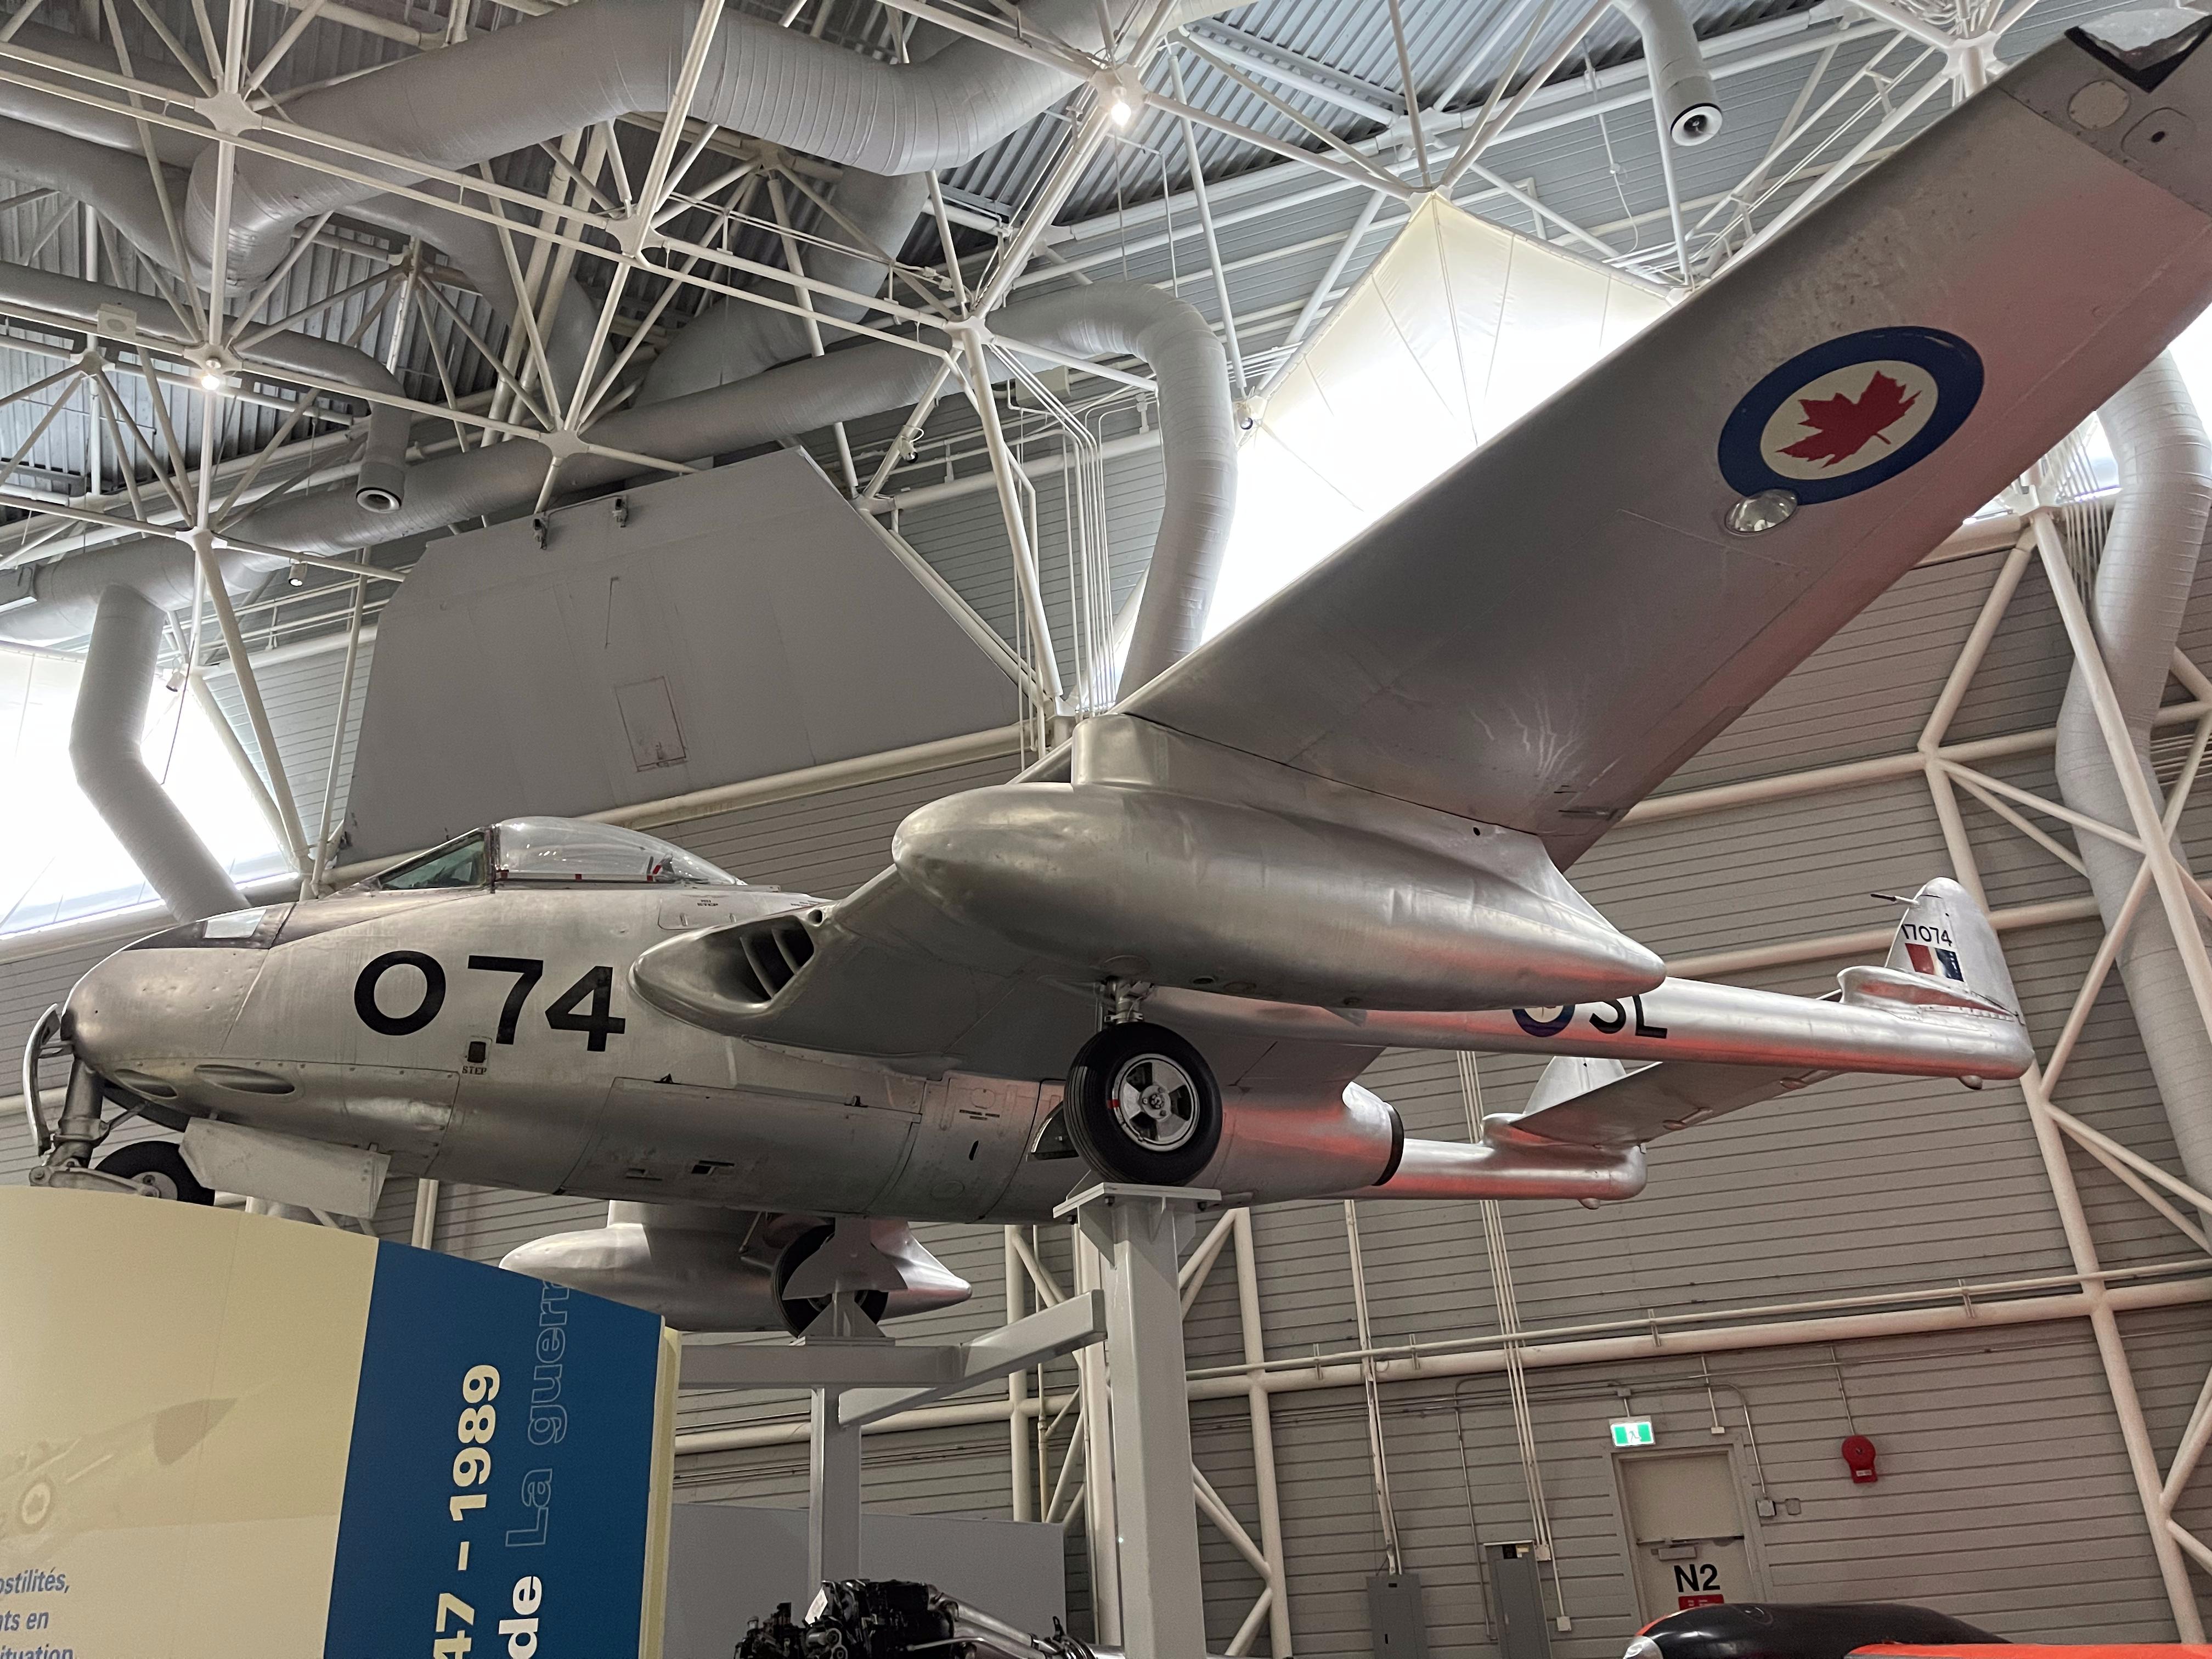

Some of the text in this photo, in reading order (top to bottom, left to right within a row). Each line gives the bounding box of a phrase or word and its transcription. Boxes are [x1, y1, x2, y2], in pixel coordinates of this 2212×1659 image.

[1901, 924, 1953, 947] 17074
[462, 1065, 487, 1075] STEP
[449, 1364, 500, 1521] 1989
[505, 1468, 553, 1547] La
[1674, 1564, 1720, 1593] N2
[26, 1611, 49, 1630] en
